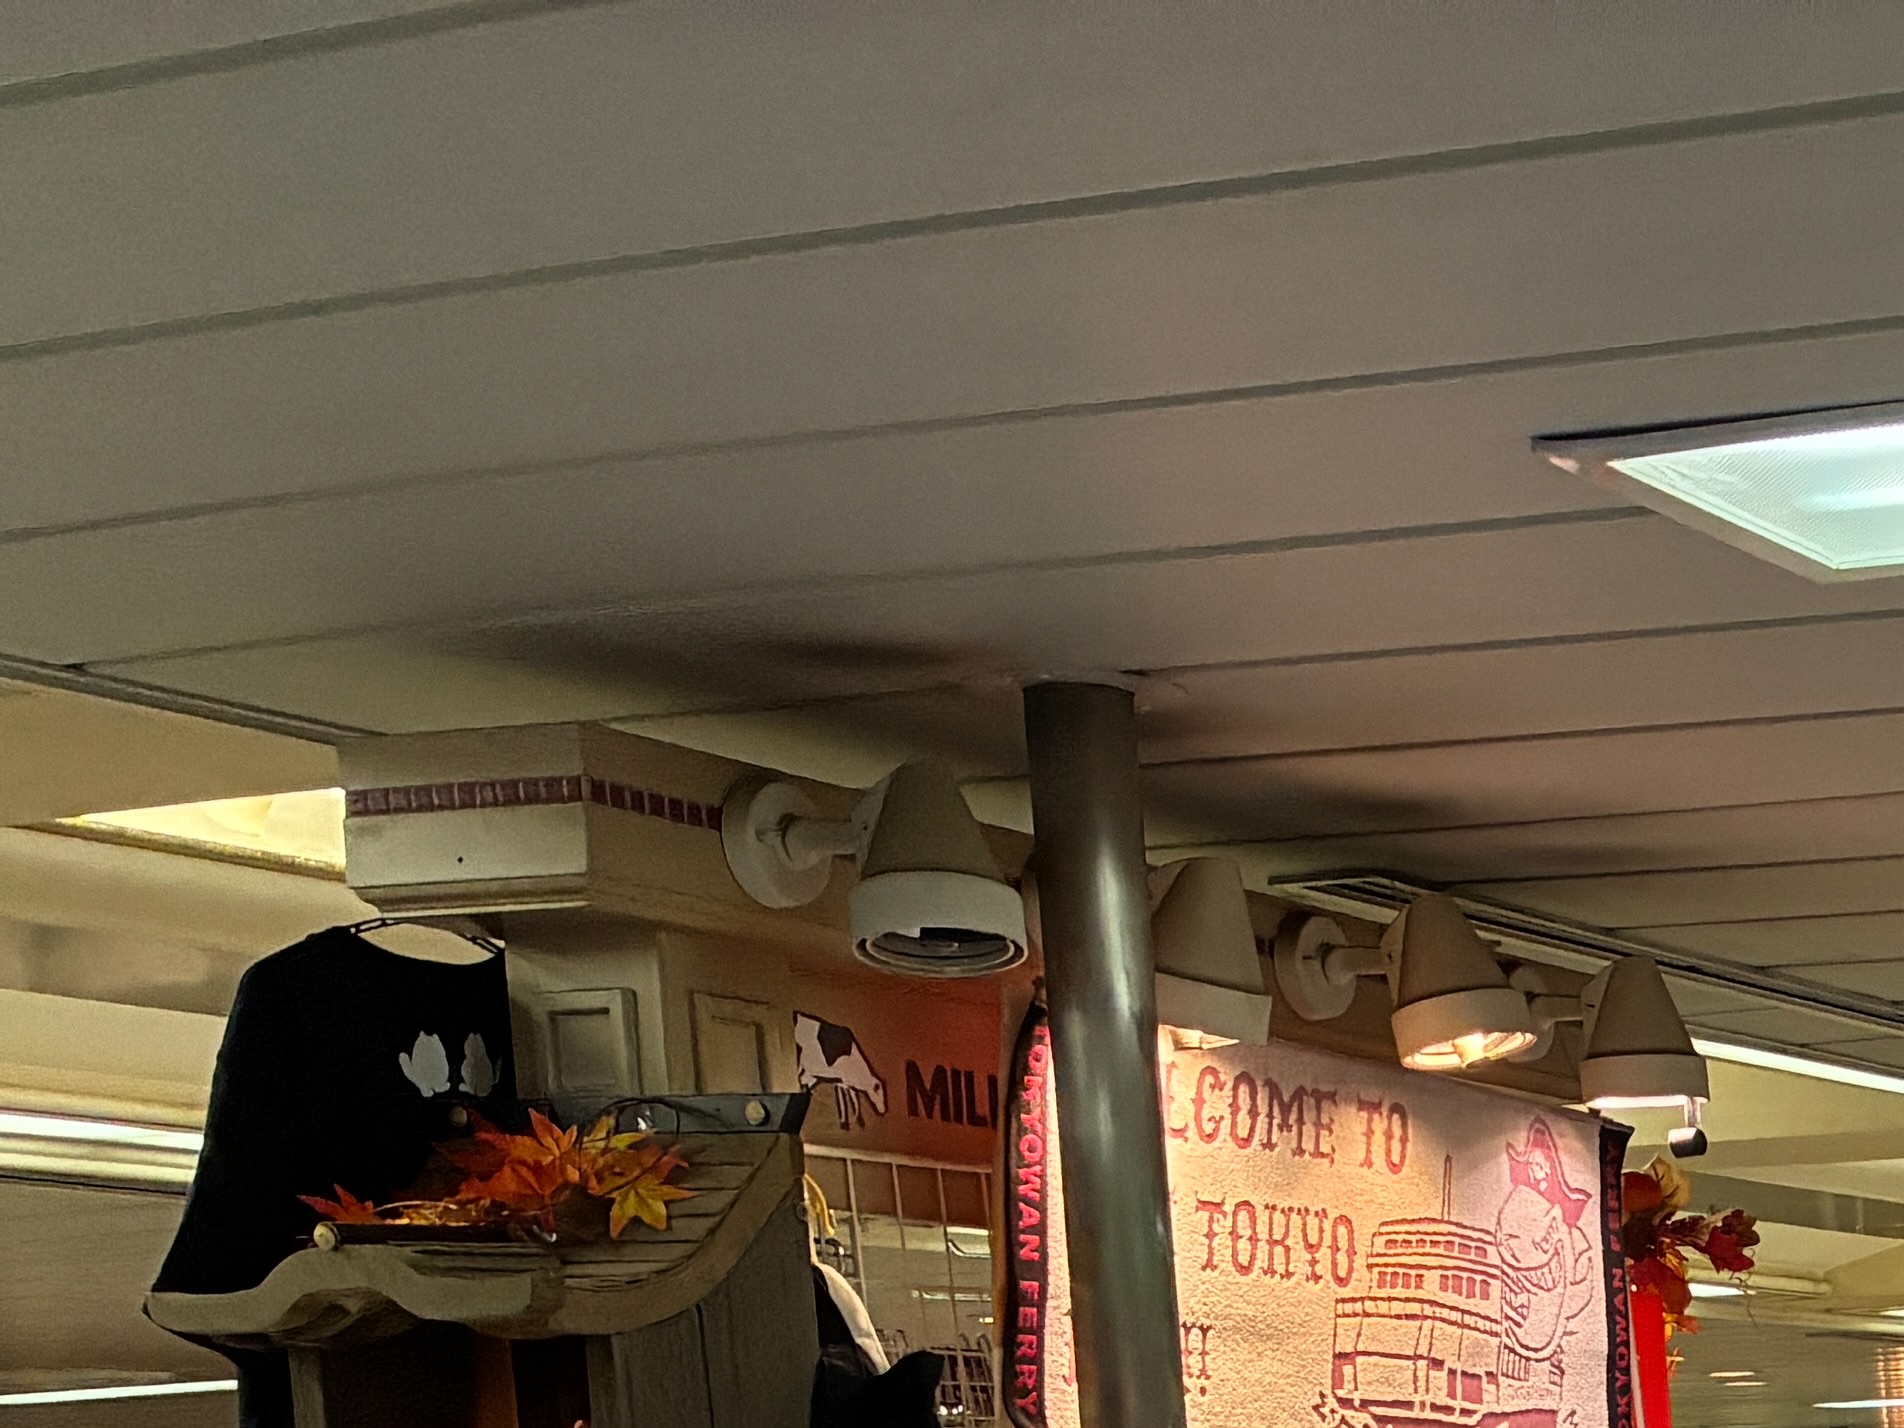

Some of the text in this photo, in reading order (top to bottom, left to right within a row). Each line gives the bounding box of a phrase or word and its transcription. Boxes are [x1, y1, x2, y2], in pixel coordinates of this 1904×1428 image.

[1164, 1060, 1410, 1175] LCOME TO
[1196, 1200, 1356, 1288] TOKYO
[1014, 1280, 1039, 1415] FERRY
